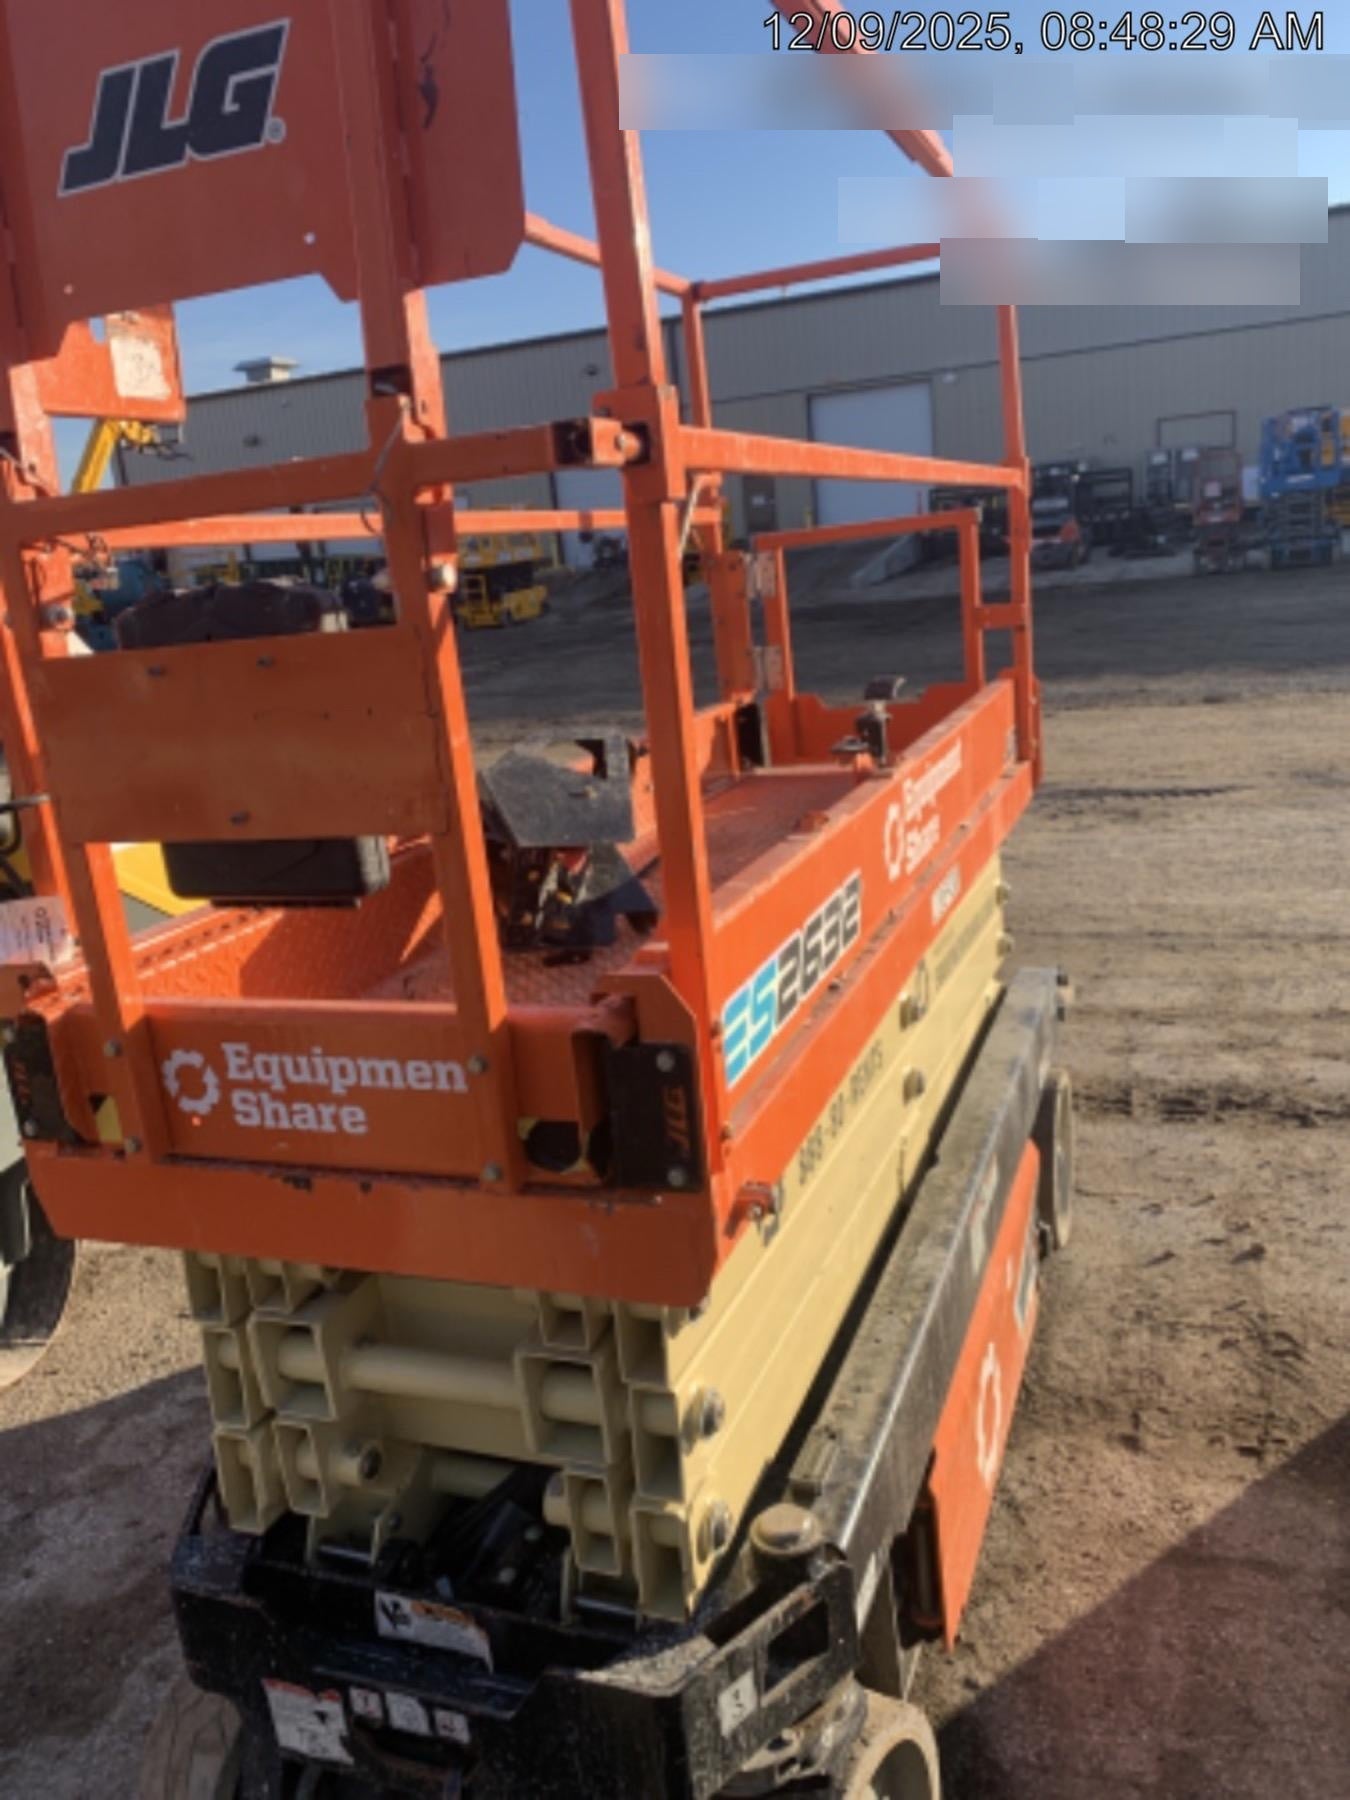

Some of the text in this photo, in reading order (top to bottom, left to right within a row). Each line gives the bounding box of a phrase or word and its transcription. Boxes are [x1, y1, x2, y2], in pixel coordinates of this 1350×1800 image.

[58, 18, 291, 197] JLG
[721, 868, 861, 1092] ES2632
[231, 1088, 368, 1134] Share
